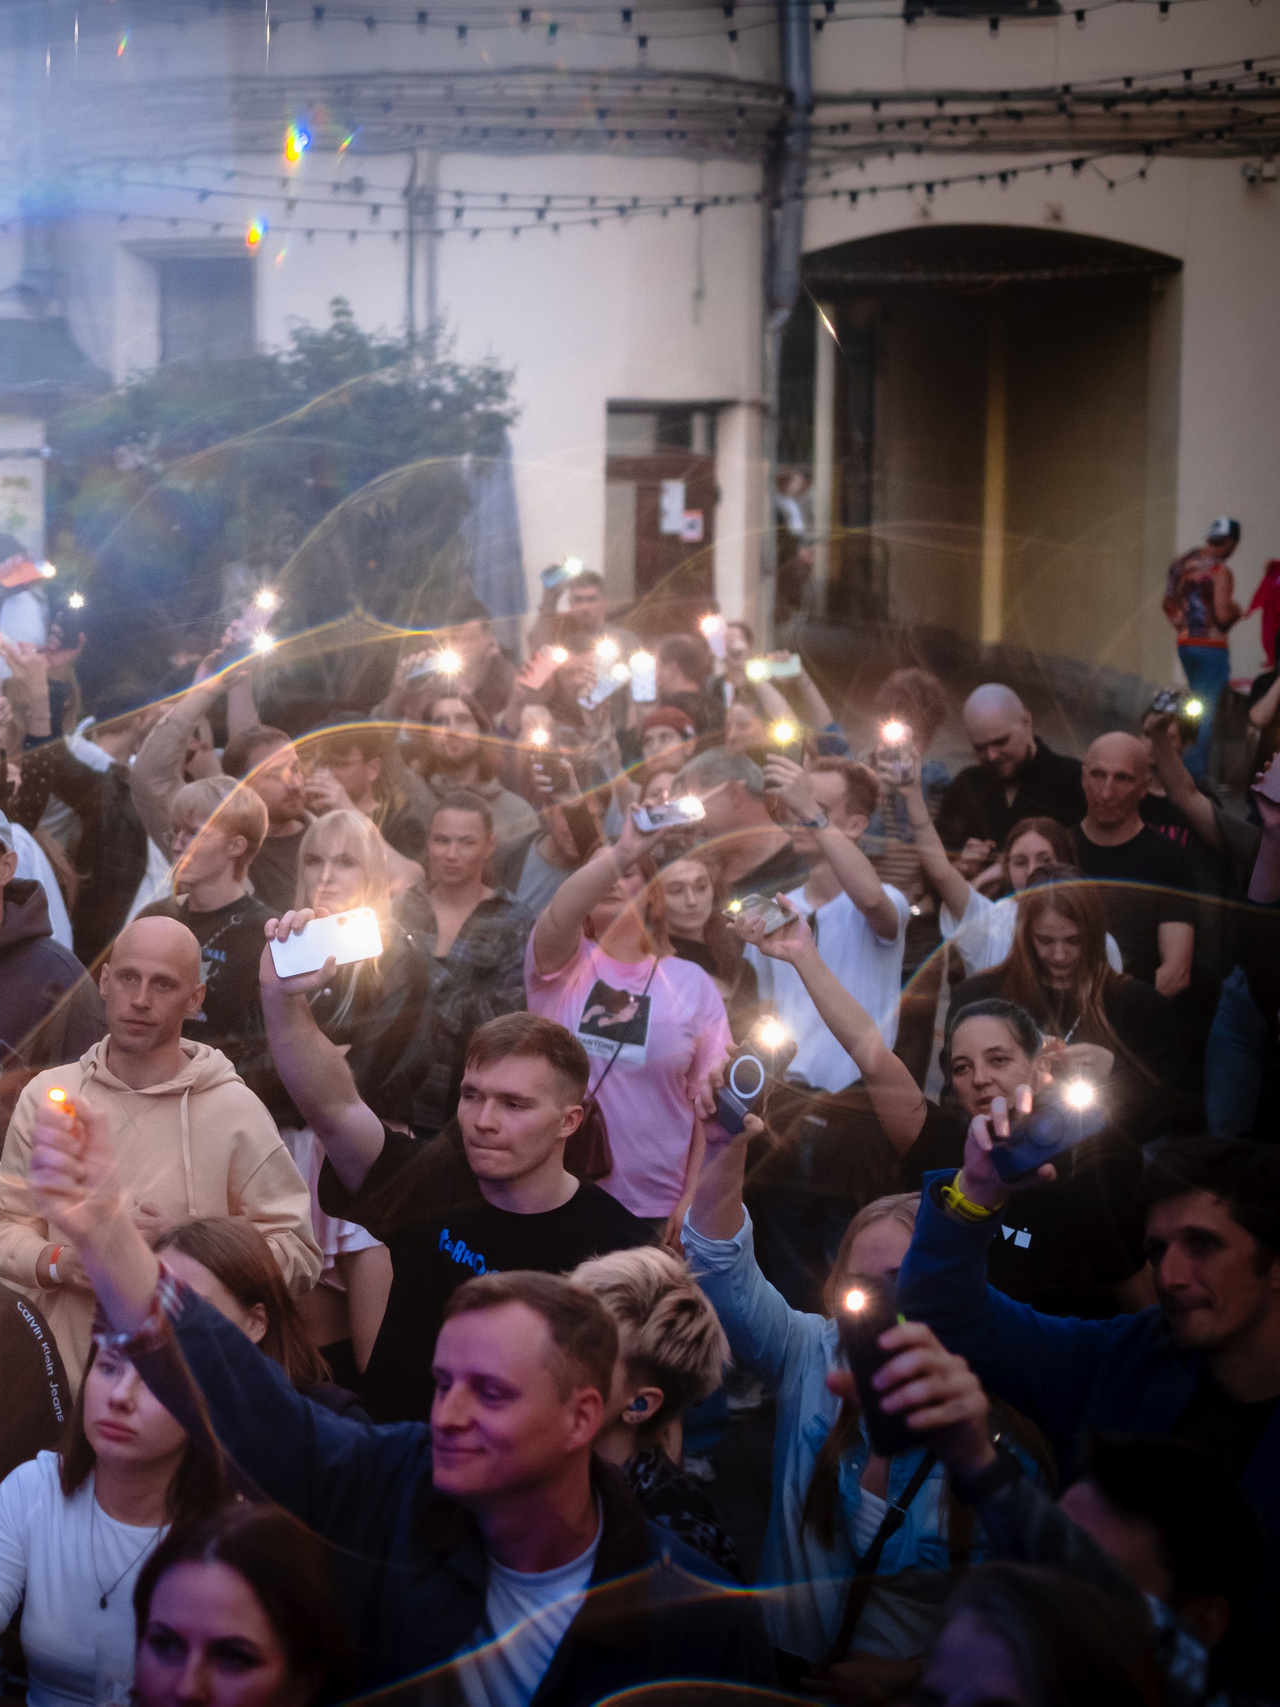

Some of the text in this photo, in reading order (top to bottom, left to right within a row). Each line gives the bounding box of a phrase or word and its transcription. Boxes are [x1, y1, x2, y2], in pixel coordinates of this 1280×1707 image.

[16, 1301, 64, 1423] Calvin Klein Jeans
